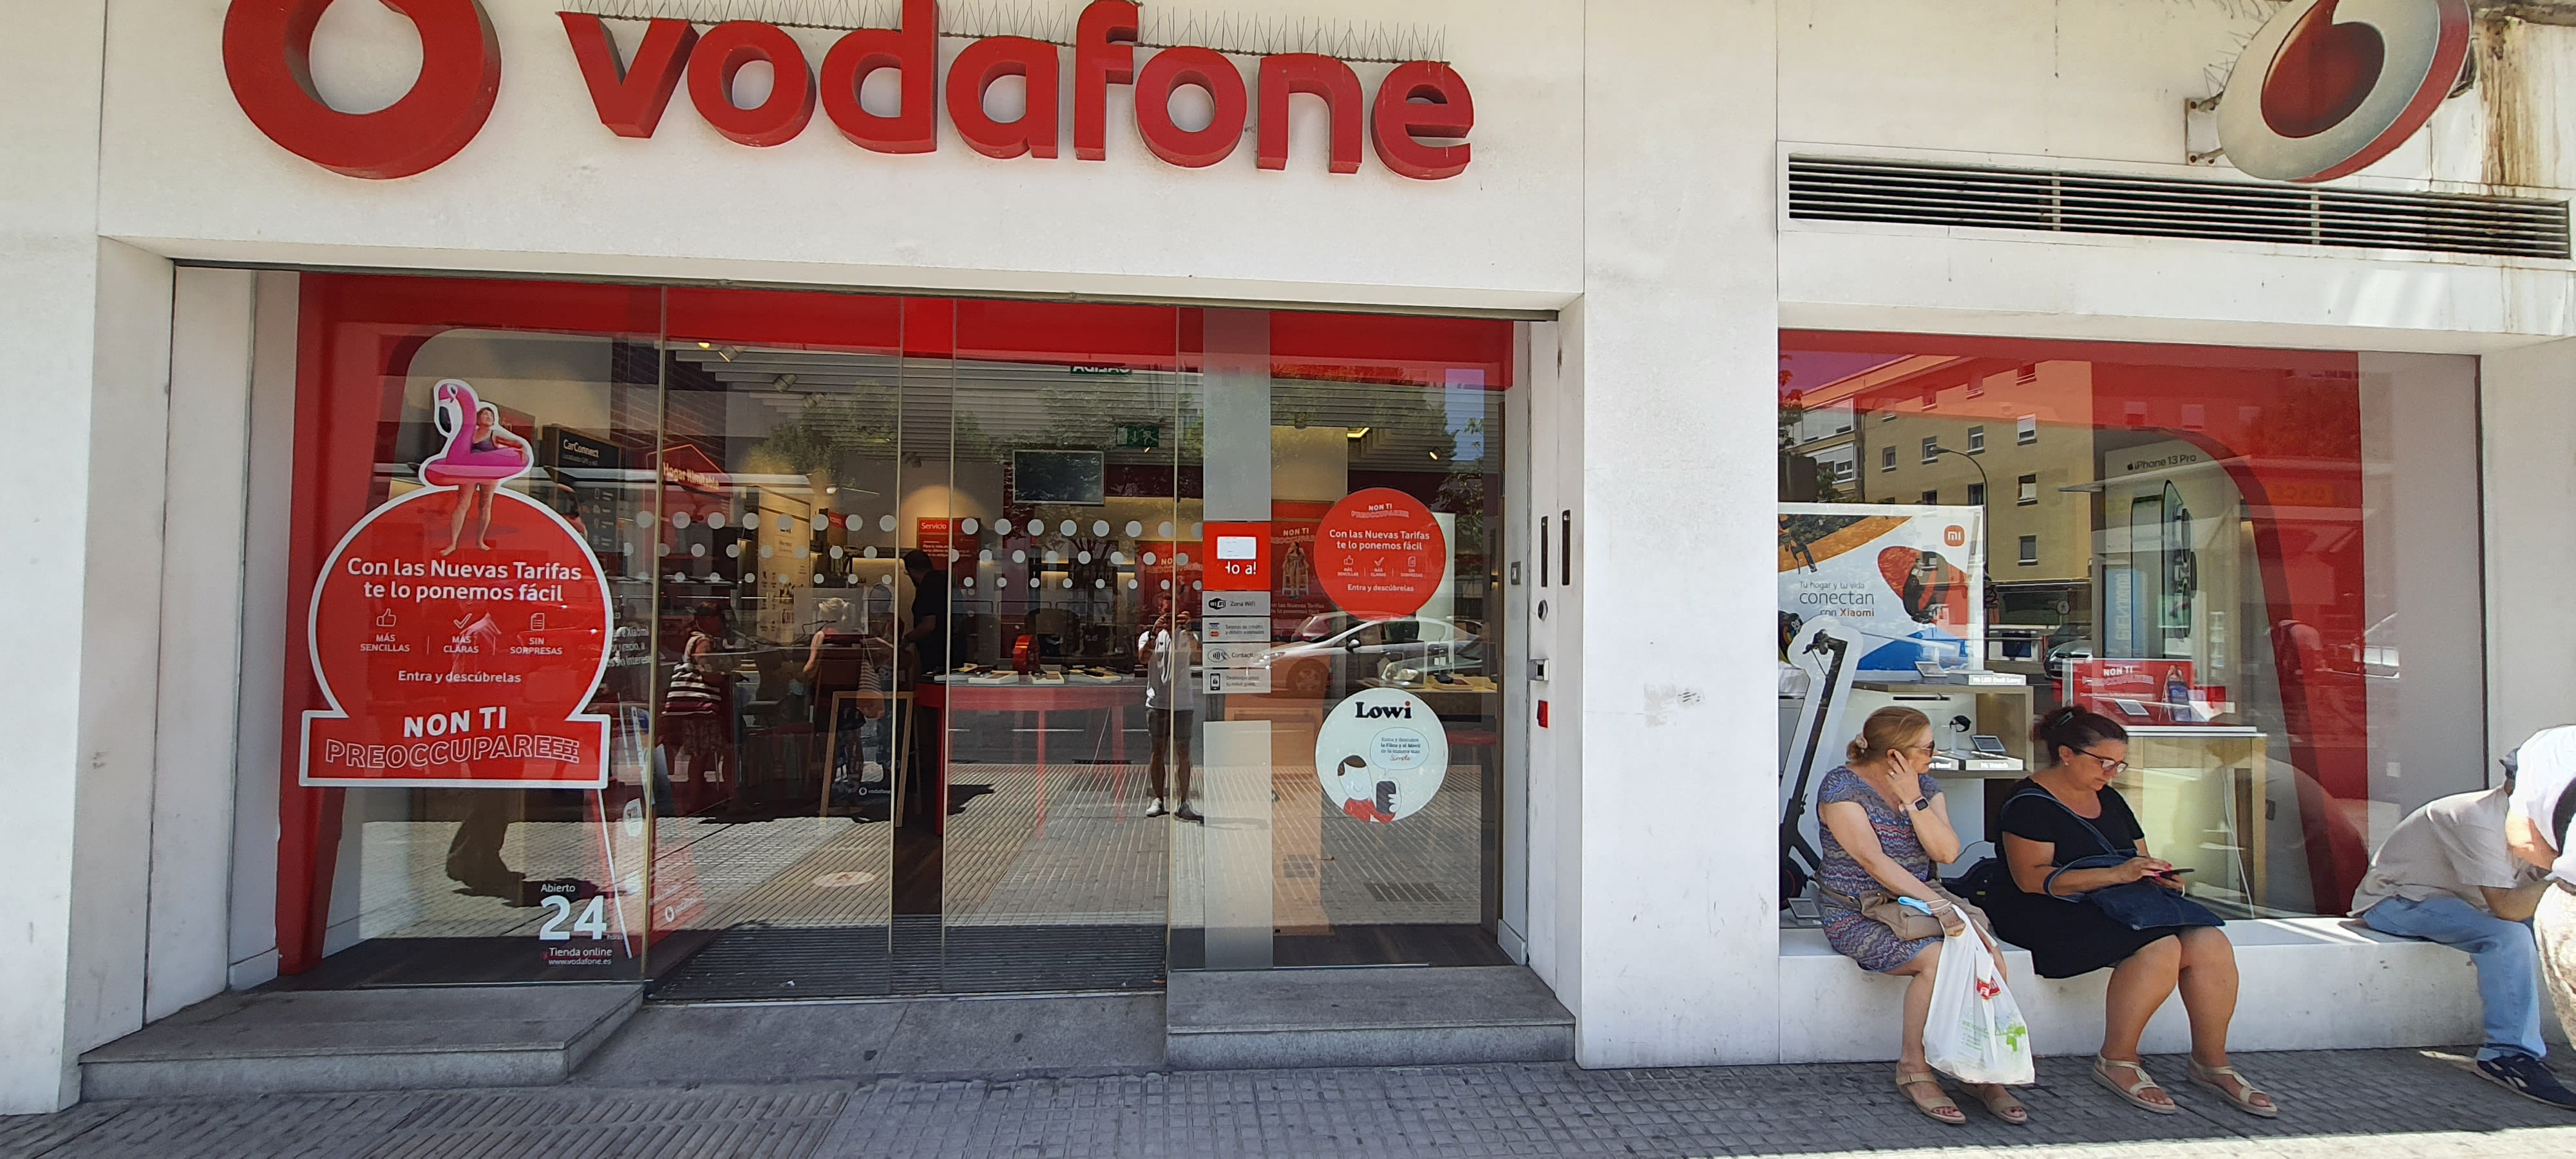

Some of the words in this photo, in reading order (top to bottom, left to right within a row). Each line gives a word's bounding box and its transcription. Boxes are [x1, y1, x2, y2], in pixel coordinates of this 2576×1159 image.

[558, 0, 1473, 180] vodafone
[2134, 458, 2166, 470] iPhone
[2168, 455, 2178, 465] 13
[2179, 454, 2196, 463] Pro
[1329, 529, 1347, 538] Con
[1349, 529, 1363, 539] las
[1365, 530, 1399, 540] Nuevas
[1400, 531, 1430, 540] Tarifas
[1336, 541, 1347, 549] te
[1349, 541, 1357, 549] lo
[1359, 542, 1401, 551] ponemos
[1403, 541, 1422, 551] fácil
[348, 558, 388, 576] Con
[394, 558, 425, 577] las
[431, 560, 509, 579] Nuevas
[513, 561, 582, 580] Tarifas
[1367, 585, 1372, 593] y
[1372, 583, 1414, 592] descúbrelas
[1810, 581, 1832, 590] hogar
[364, 581, 385, 598] te
[391, 581, 411, 599] lo
[416, 585, 514, 603] ponemos
[518, 584, 564, 602] fácil
[1799, 590, 1875, 605] conectan
[1840, 608, 1875, 617] Xiaomi
[375, 632, 396, 642] MÁS
[452, 634, 471, 643] MÁS
[529, 637, 544, 646] SIN
[360, 643, 410, 652] SENCILLAS
[443, 645, 479, 654] CLARAS
[510, 646, 563, 655] SORPRESAS
[2103, 667, 2123, 676] NON
[398, 670, 432, 682] Entra
[434, 673, 443, 684] y
[446, 671, 522, 684] descúbrelas
[1354, 701, 1412, 719] Lowi
[404, 710, 470, 738] NON
[478, 706, 507, 730] TI
[541, 883, 576, 892] Abierto
[539, 894, 607, 940] 24
[549, 947, 581, 956] Tienda
[582, 947, 612, 956] online
